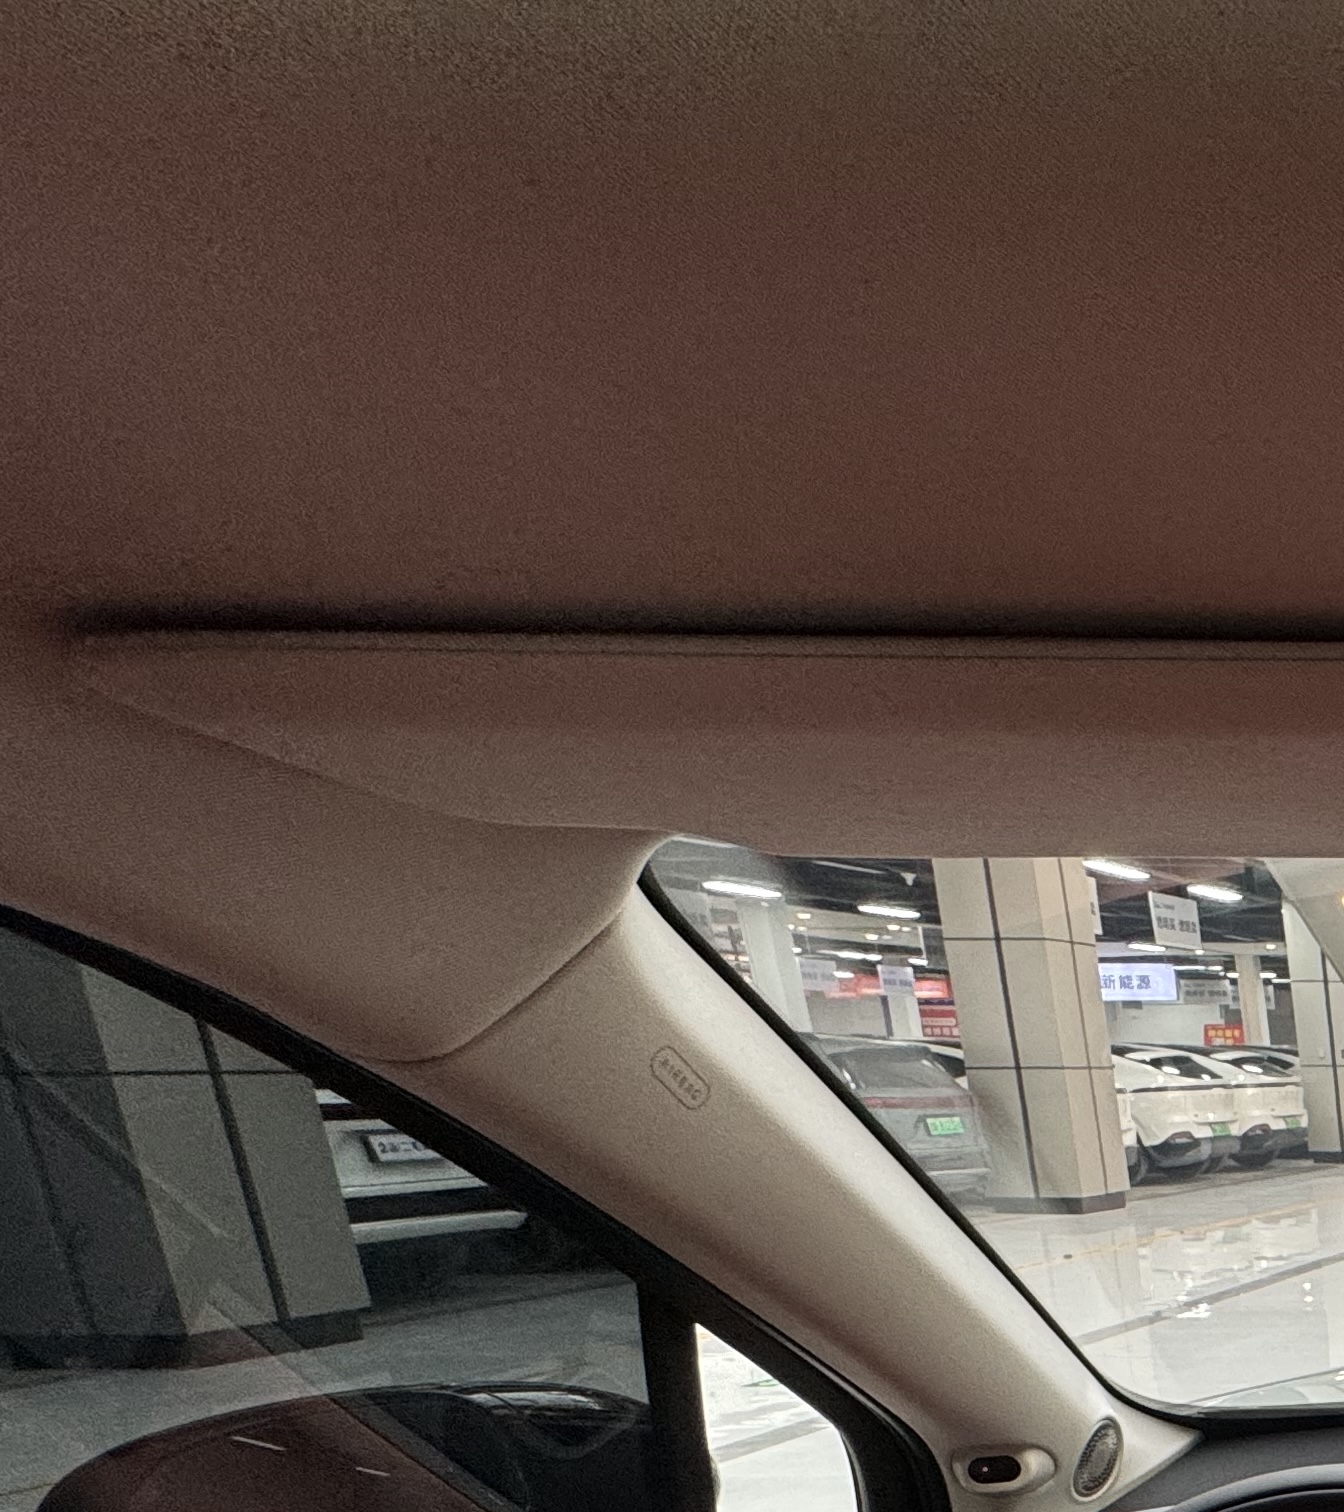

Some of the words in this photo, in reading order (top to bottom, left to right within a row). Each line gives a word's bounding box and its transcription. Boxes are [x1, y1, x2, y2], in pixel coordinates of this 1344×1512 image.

[1101, 974, 1152, 990] 新能源
[660, 1058, 701, 1100] AIRBAG
